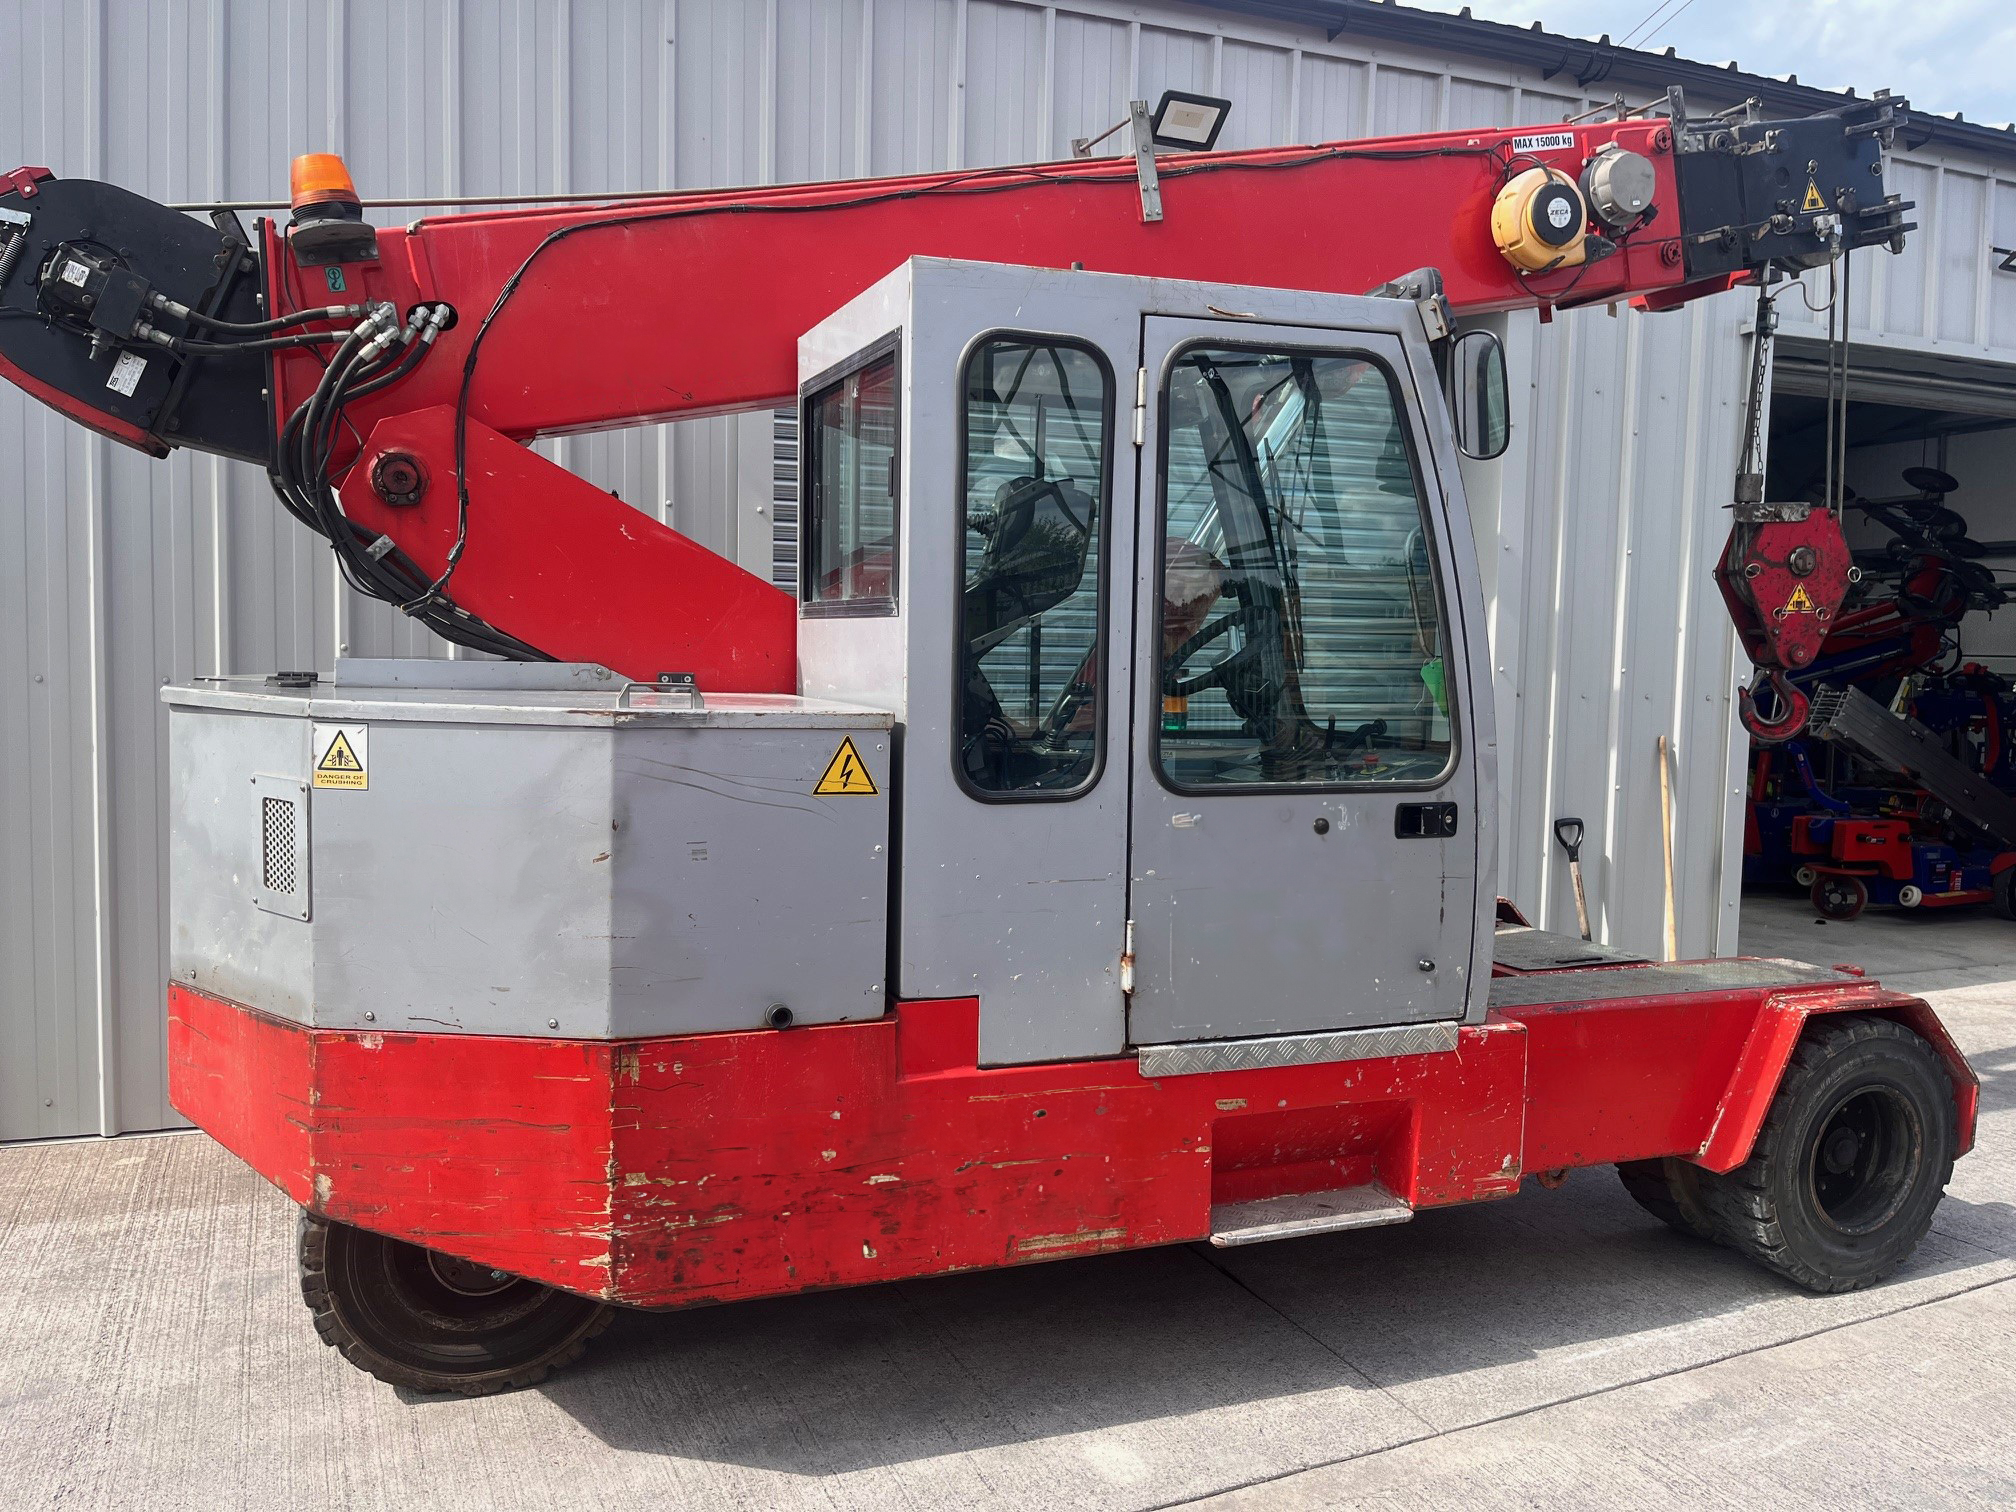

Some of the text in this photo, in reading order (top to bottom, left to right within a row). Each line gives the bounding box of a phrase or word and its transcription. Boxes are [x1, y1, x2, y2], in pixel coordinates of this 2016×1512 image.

[1514, 135, 1572, 149] MAX 15000 kg
